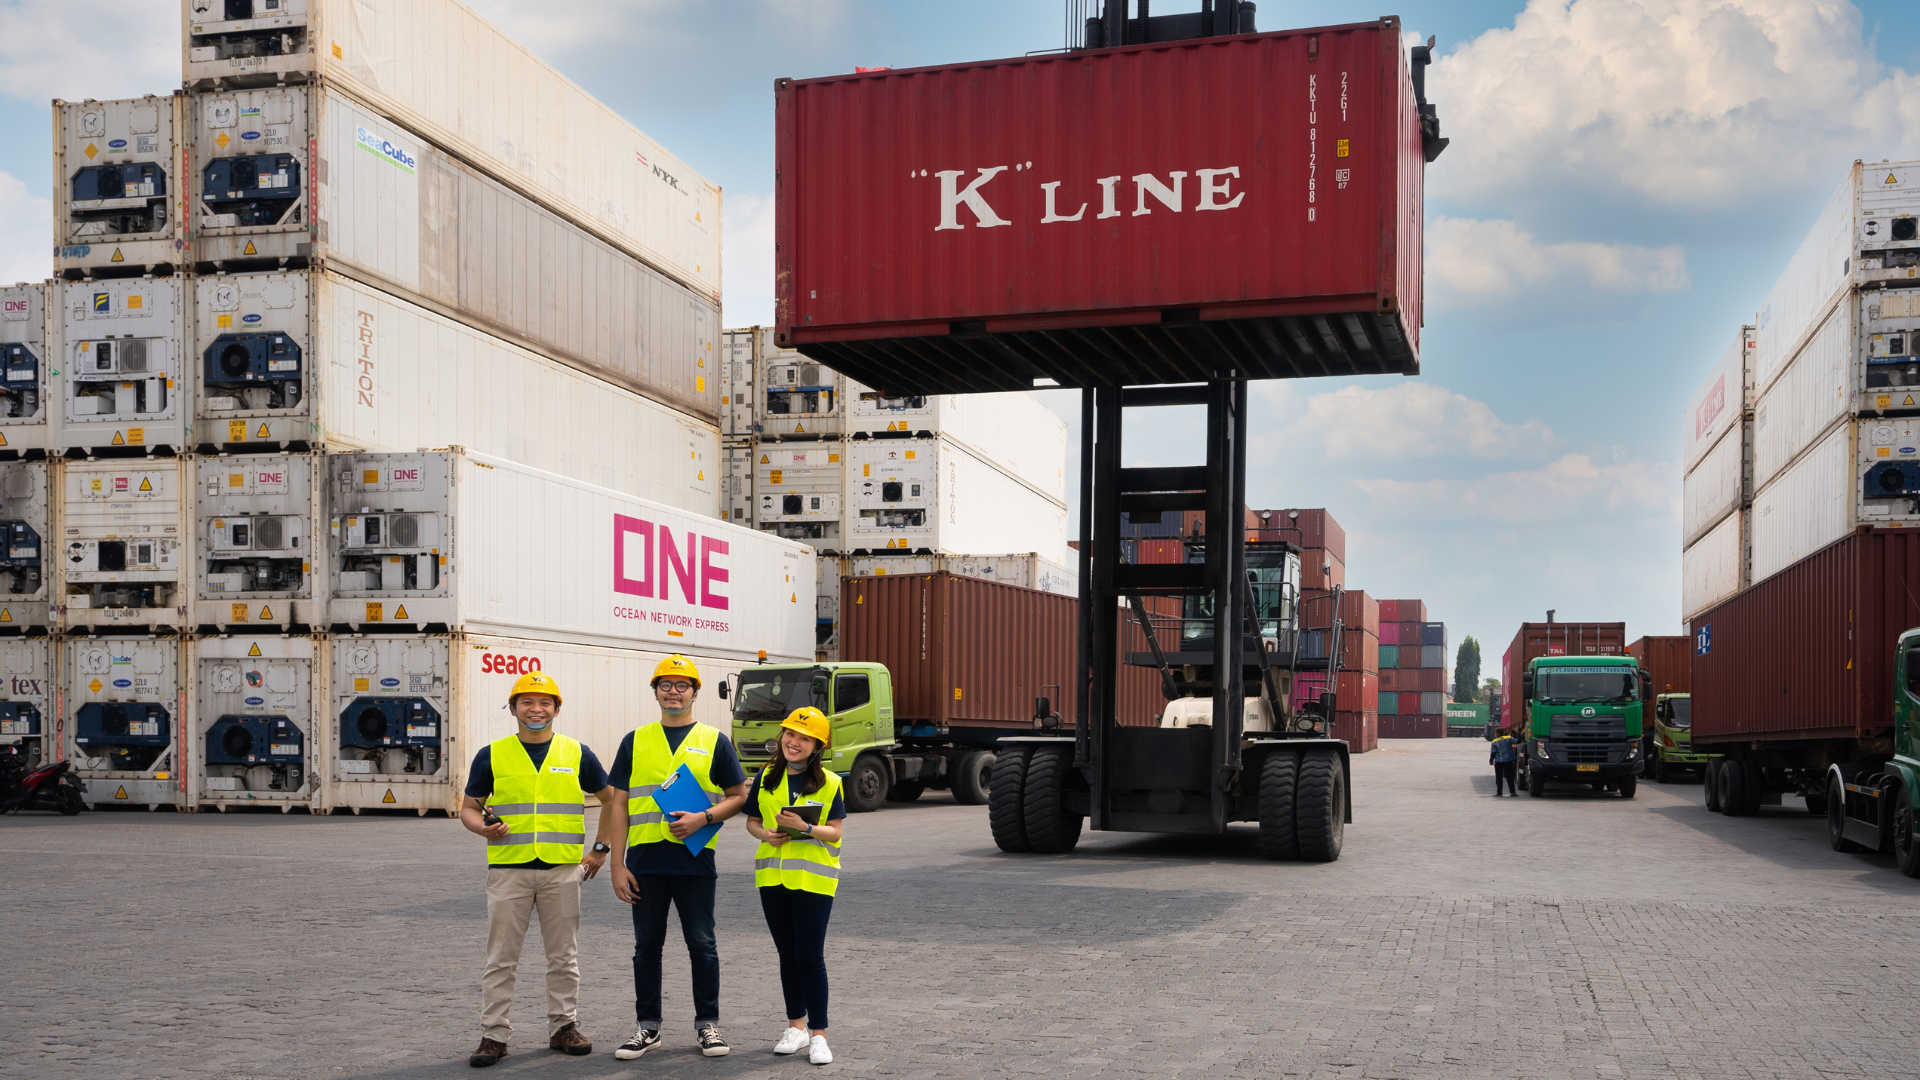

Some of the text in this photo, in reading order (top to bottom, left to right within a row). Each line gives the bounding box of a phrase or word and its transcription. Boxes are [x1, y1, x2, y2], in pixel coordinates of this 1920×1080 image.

[1340, 72, 1348, 122] 22G1
[264, 129, 276, 137] SZLU
[263, 138, 282, 146] 907530
[358, 126, 414, 168] SeaCube
[652, 164, 678, 190] NYK
[1040, 166, 1246, 224] LINE
[1308, 207, 1316, 222] 0
[5, 301, 27, 311] ONE
[358, 310, 374, 408] TRITON
[259, 473, 282, 482] ONE
[394, 470, 418, 480] ONE
[614, 512, 729, 610] ONE
[614, 606, 729, 632] OCEAN NETWORK EXPRESS
[482, 652, 541, 675] seaco
[11, 674, 42, 696] tex
[381, 678, 399, 686] Carrier
[409, 676, 422, 684] SEGU
[135, 687, 153, 695] 907741
[409, 685, 428, 693] 923750
[246, 697, 263, 705] Carrier
